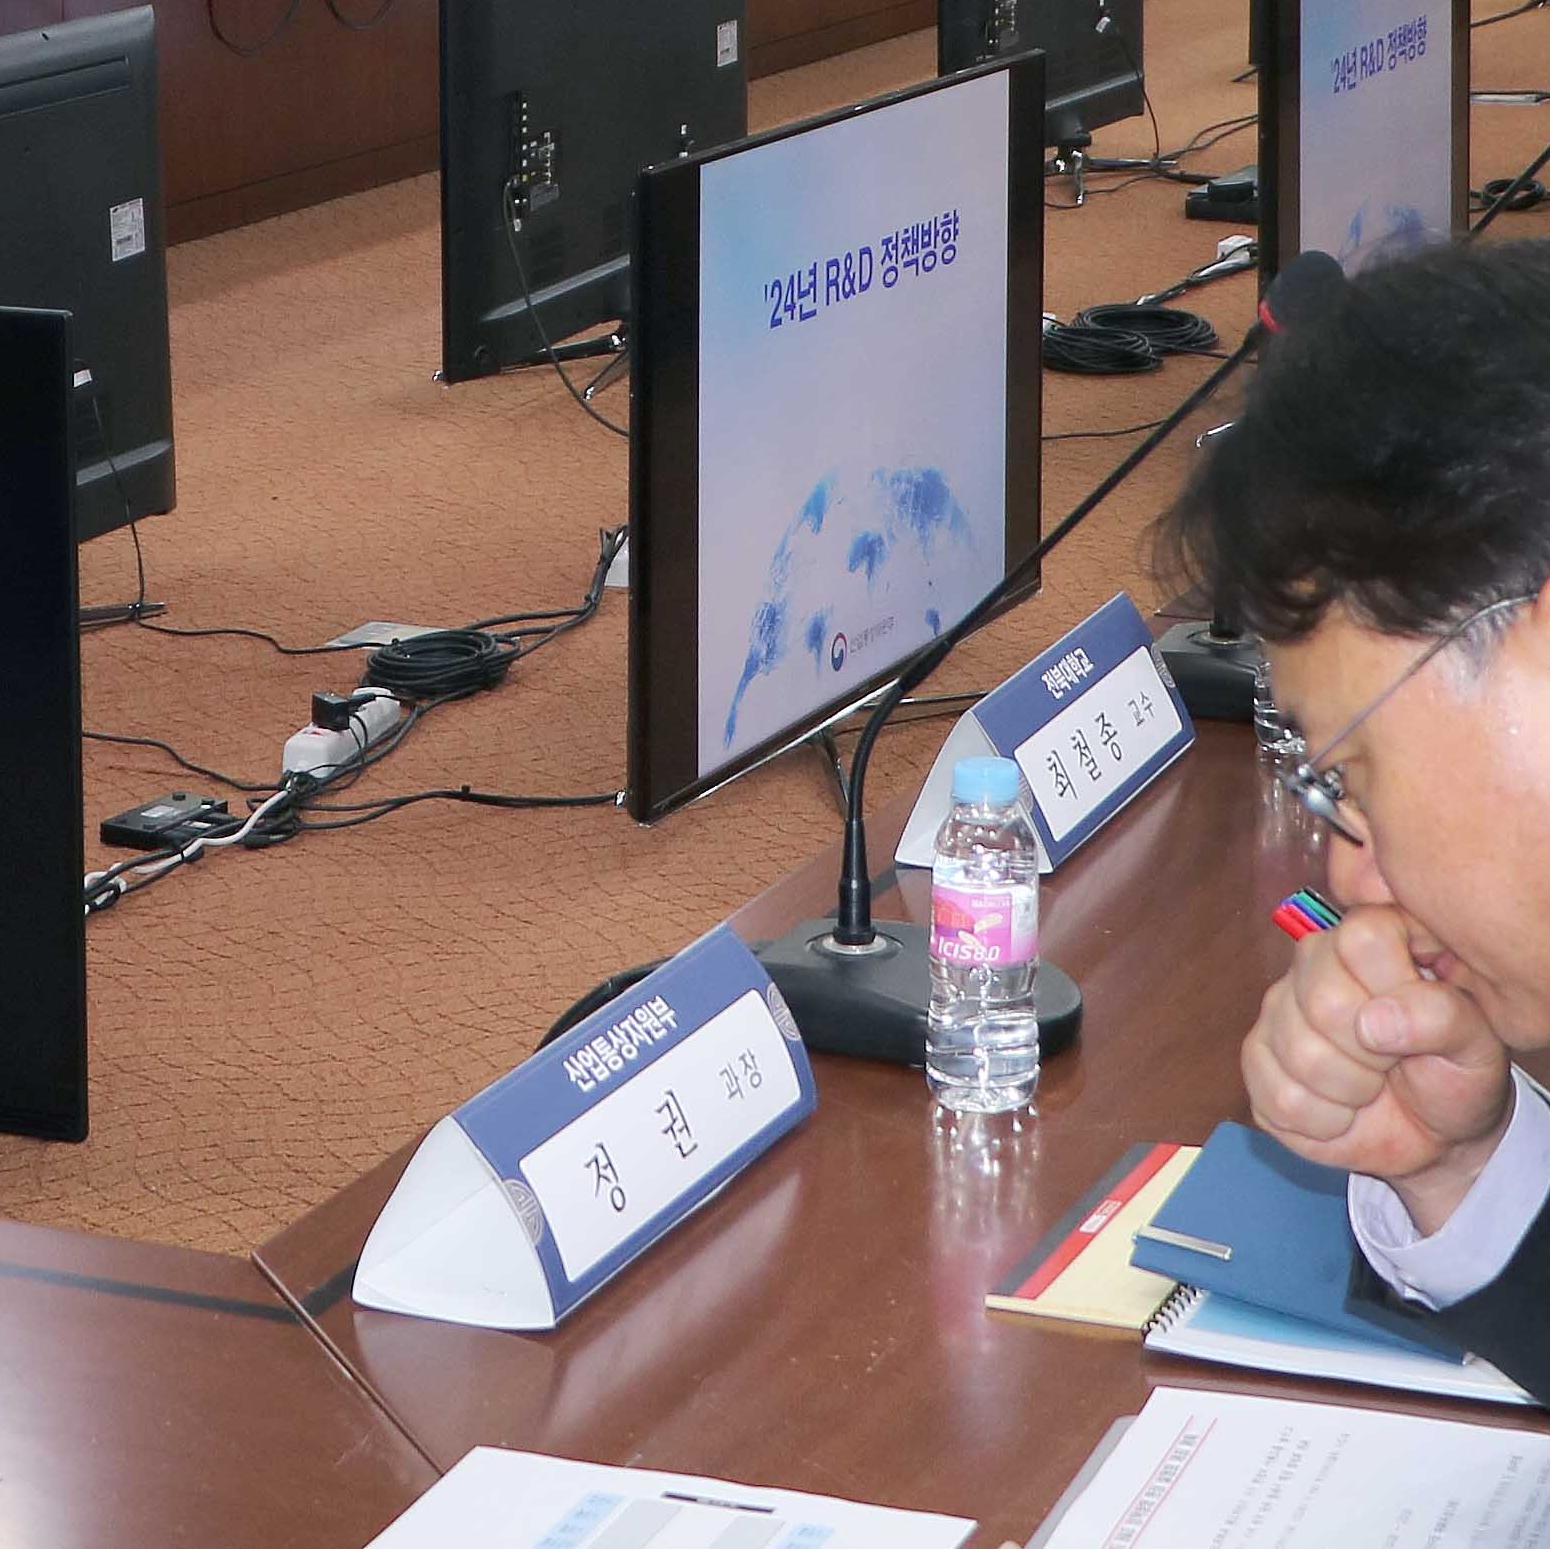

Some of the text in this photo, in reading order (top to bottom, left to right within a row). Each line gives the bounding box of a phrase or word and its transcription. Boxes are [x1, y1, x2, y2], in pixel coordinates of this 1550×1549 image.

[1360, 38, 1384, 81] R&D
[1387, 13, 1428, 70] 정책방향
[763, 208, 960, 330] '24년 R&D 정책방향
[1040, 647, 1096, 700] 전북대학교
[1126, 690, 1156, 727] 교수
[561, 993, 679, 1093] 산업통상자원부
[717, 1047, 763, 1101] 과장
